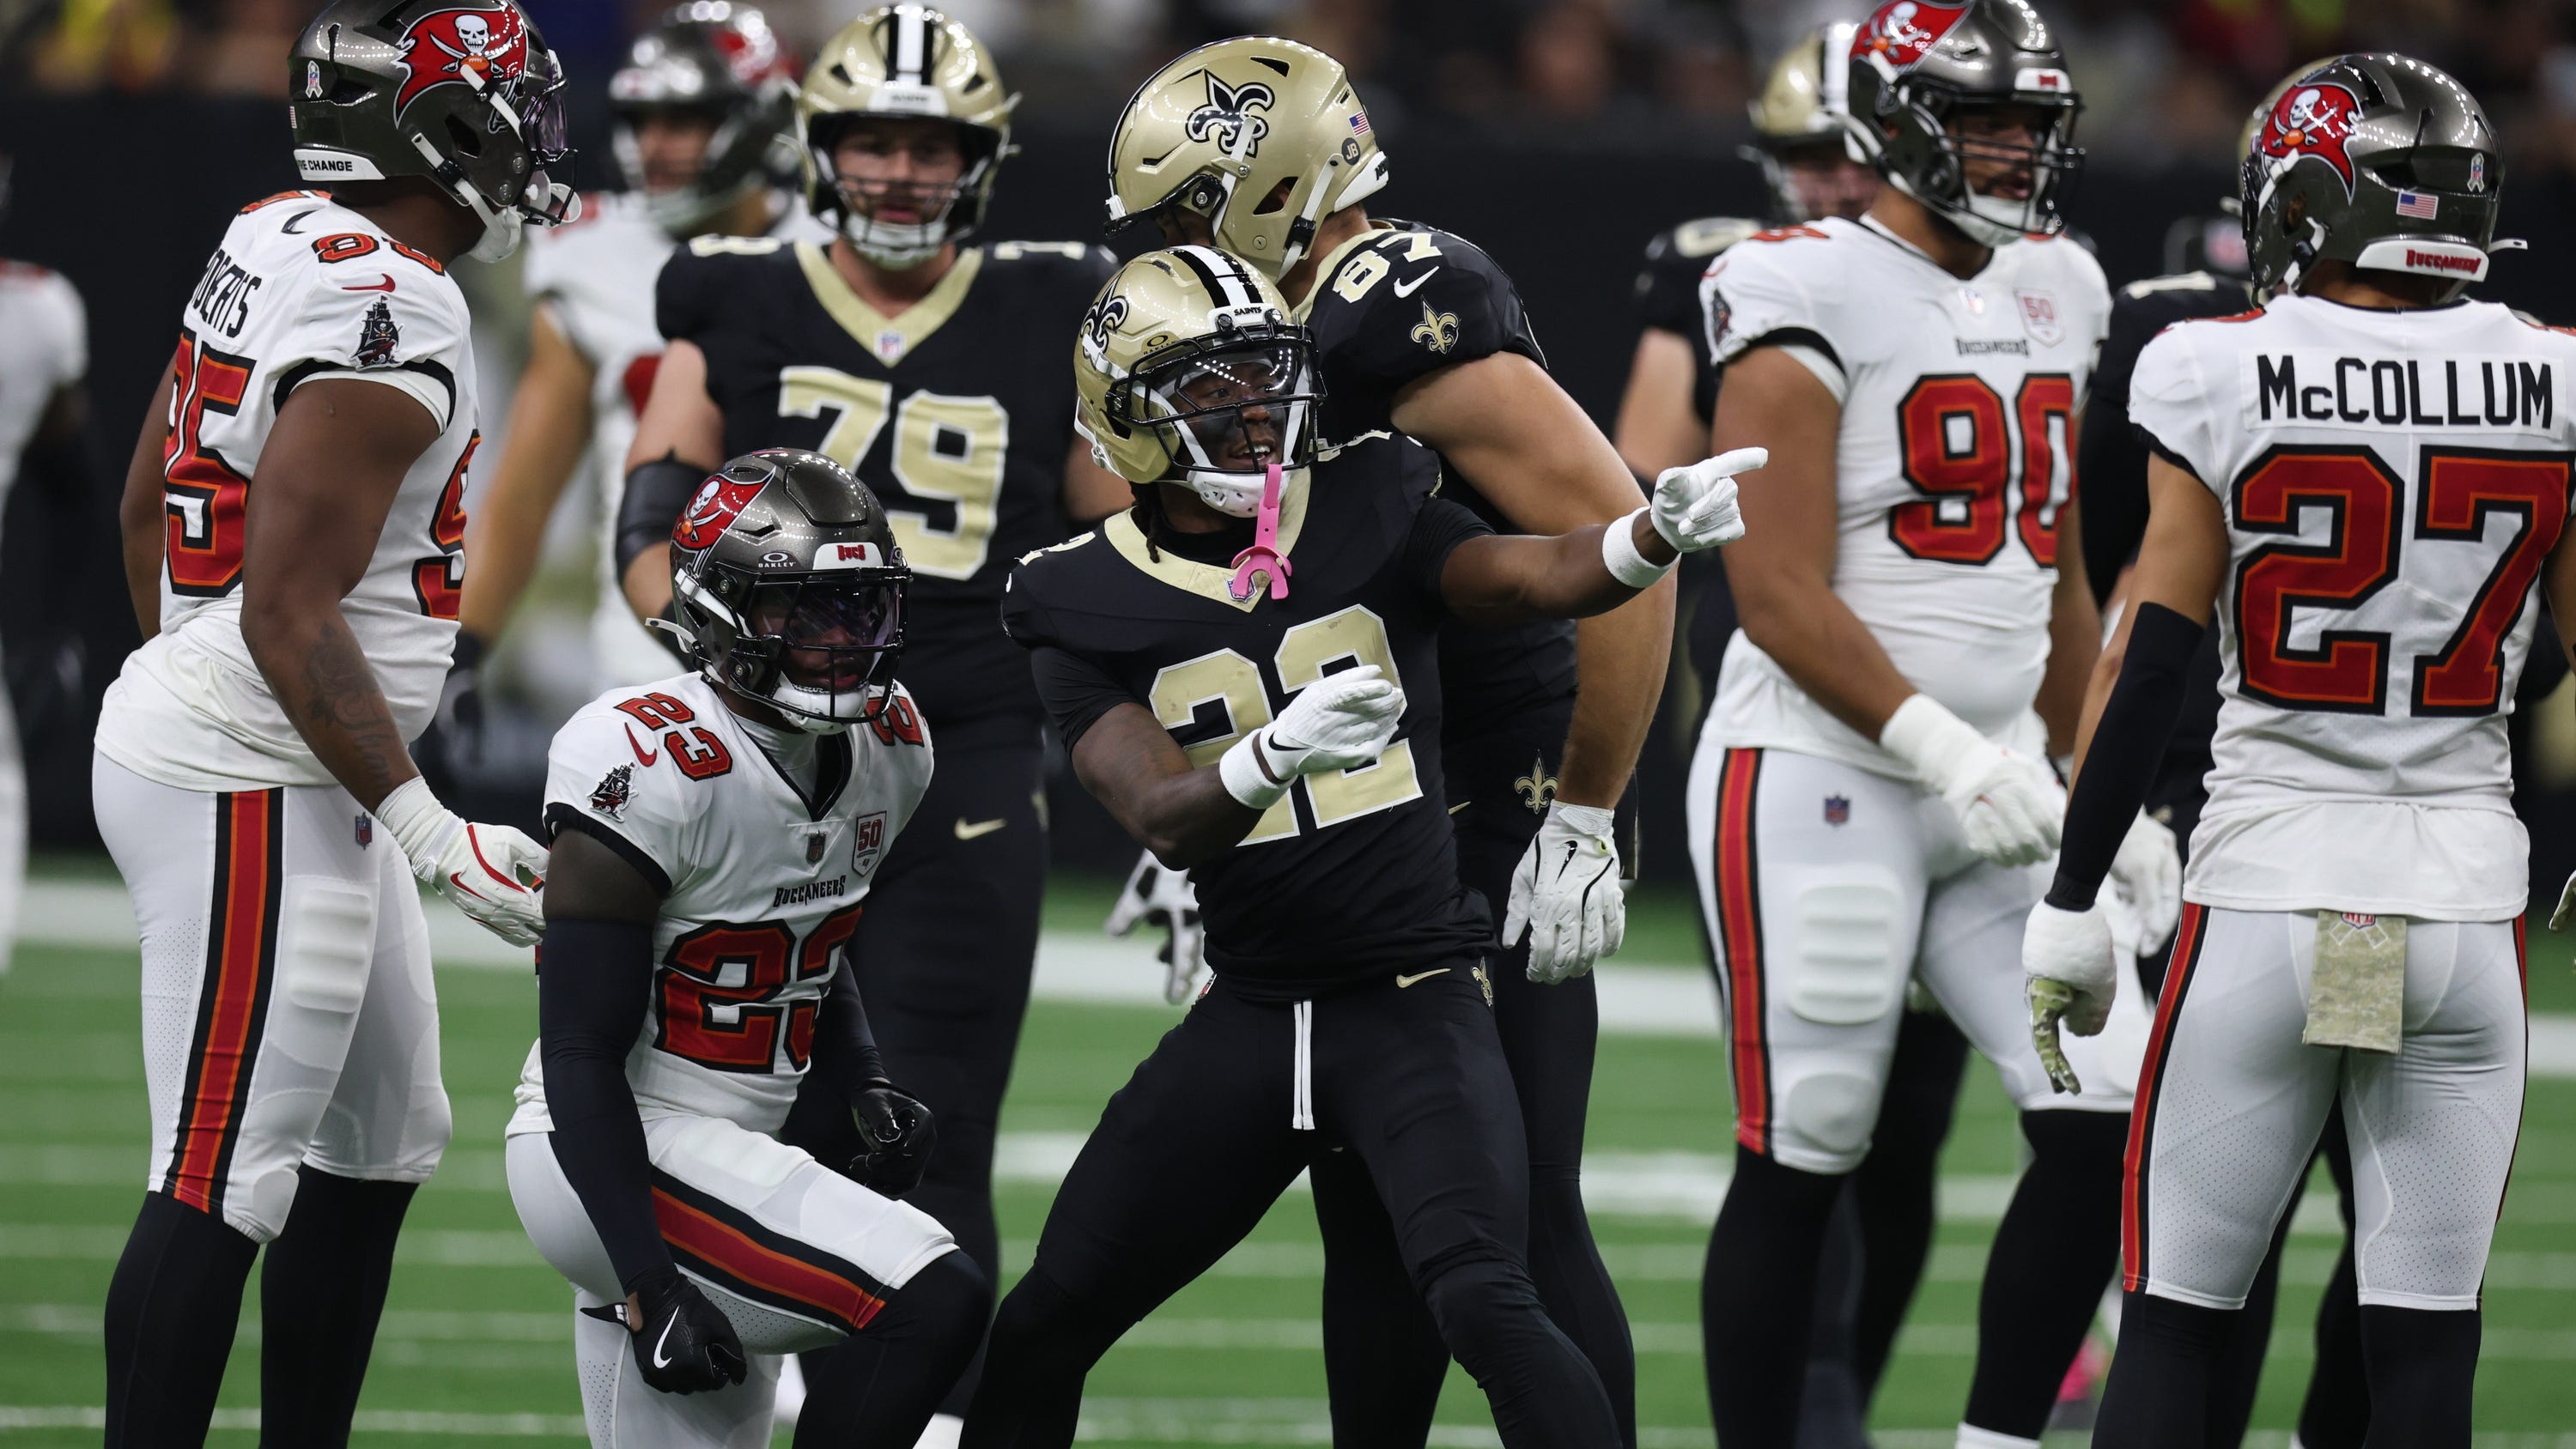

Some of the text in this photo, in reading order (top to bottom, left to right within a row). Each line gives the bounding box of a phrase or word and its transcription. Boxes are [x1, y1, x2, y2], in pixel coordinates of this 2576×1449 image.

[308, 160, 353, 172] CHANGE
[1346, 142, 1359, 161] JB
[1332, 232, 1443, 304] 87
[1233, 306, 1262, 316] SAINTS
[2257, 354, 2553, 429] McCOLLUM
[778, 365, 1010, 581] 79
[1886, 373, 2080, 568] 90
[2232, 443, 2576, 718] 27
[613, 692, 733, 782] 23
[1148, 603, 1425, 847] 22
[858, 819, 883, 851] 50
[773, 875, 847, 908] BUCCANEERS
[652, 905, 863, 1075] 23
